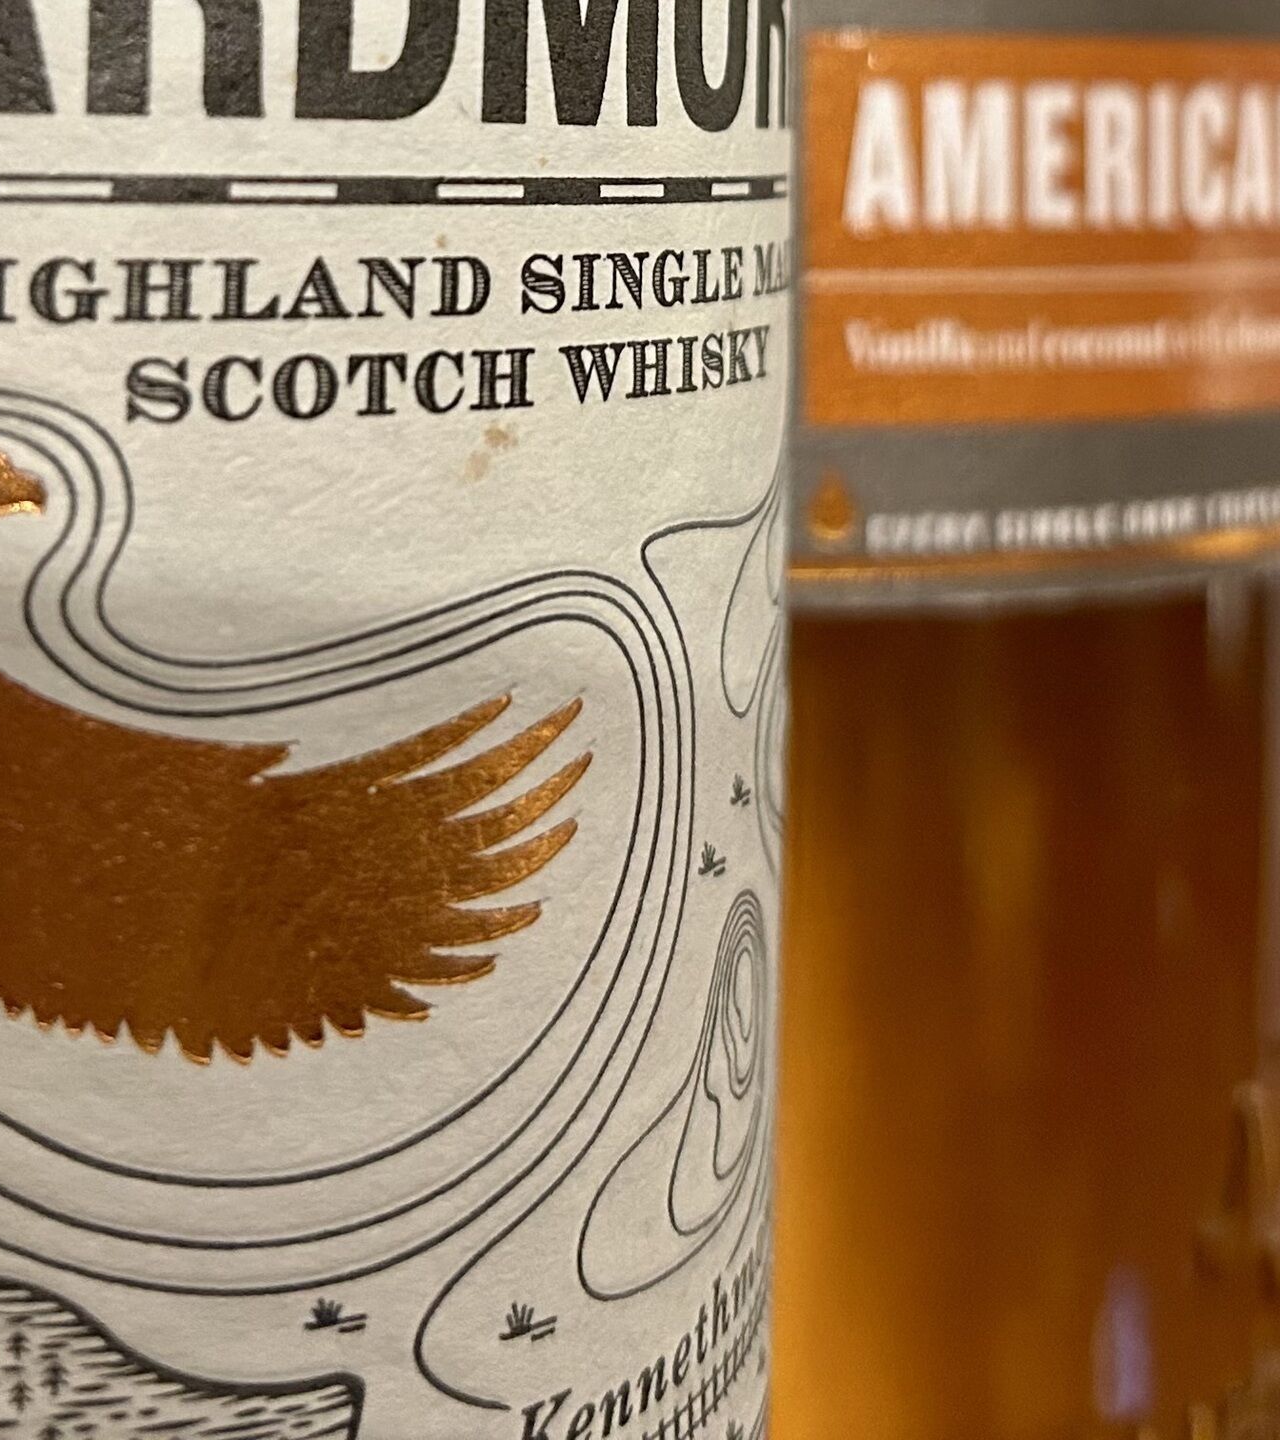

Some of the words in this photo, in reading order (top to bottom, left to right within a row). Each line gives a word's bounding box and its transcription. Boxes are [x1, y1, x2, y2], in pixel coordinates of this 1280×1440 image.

[521, 245, 744, 314] SINGLE
[125, 346, 534, 423] SCOTCH
[559, 324, 770, 403] WHISKY
